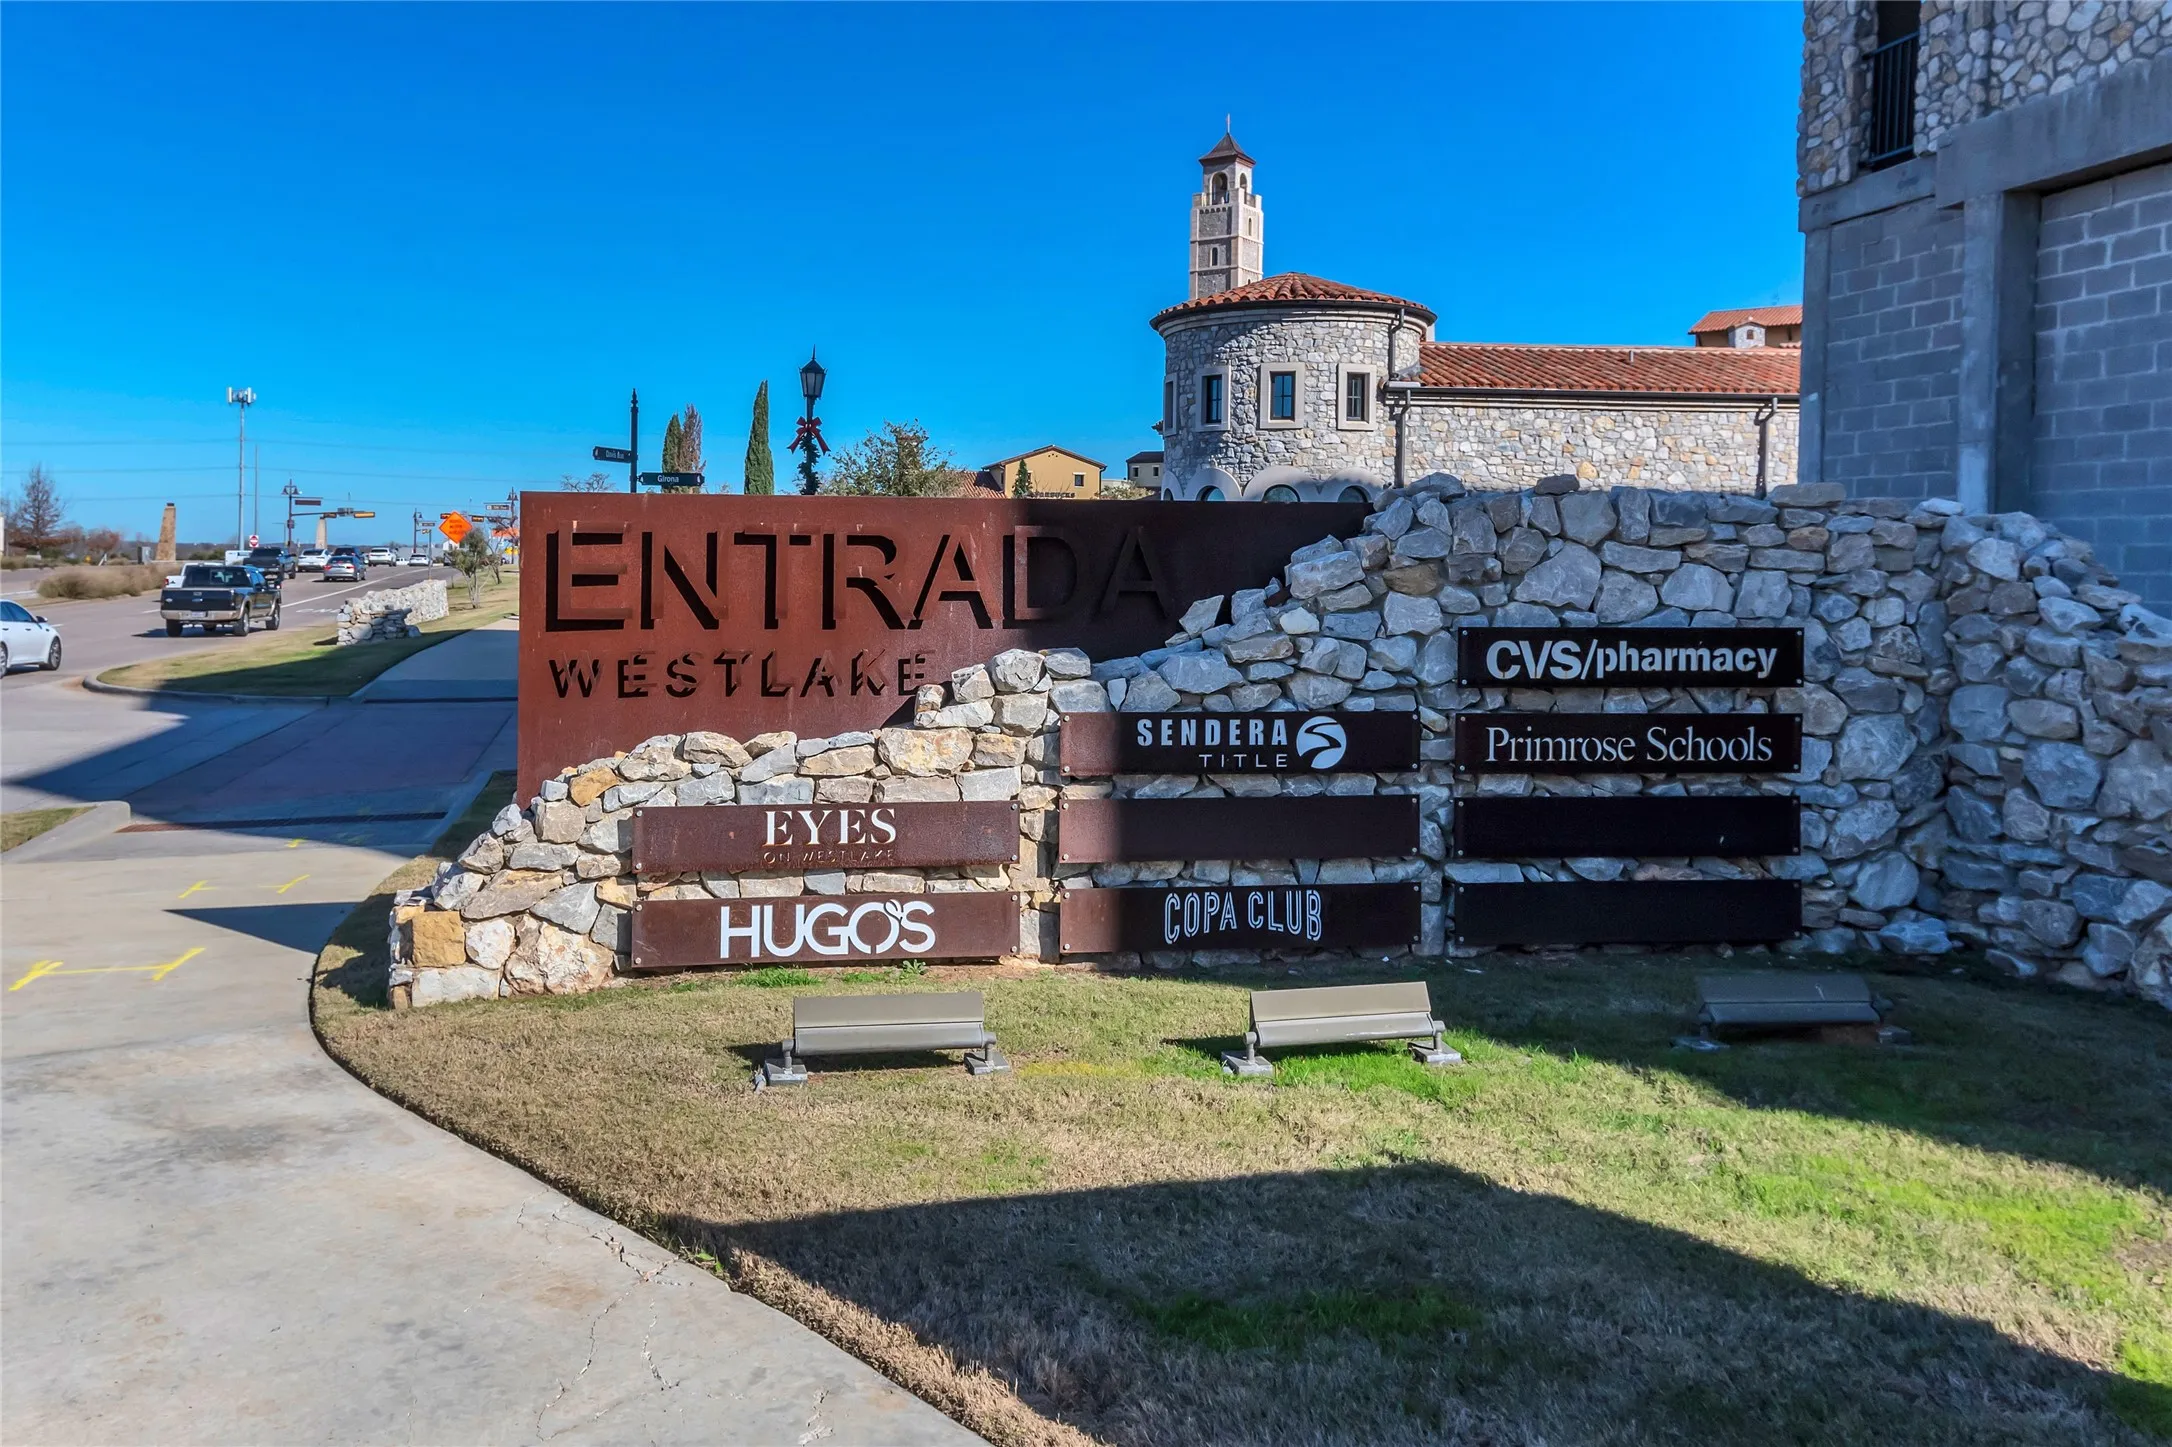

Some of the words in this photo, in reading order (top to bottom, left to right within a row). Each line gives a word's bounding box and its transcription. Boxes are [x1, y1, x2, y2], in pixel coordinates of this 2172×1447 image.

[657, 474, 680, 483] Girona
[546, 520, 1171, 632] ENTRADA
[549, 648, 935, 698] WESTLAKE
[1486, 638, 1778, 680] CVS/pharmacy
[1137, 718, 1288, 747] SENDERA
[1485, 725, 1636, 762] Primrose
[1646, 725, 1773, 762] Schools
[1198, 753, 1288, 768] TITLE
[762, 808, 897, 847] EYES
[763, 851, 791, 863] ON
[1164, 891, 1238, 945] COPA
[1247, 889, 1322, 942] CLUB
